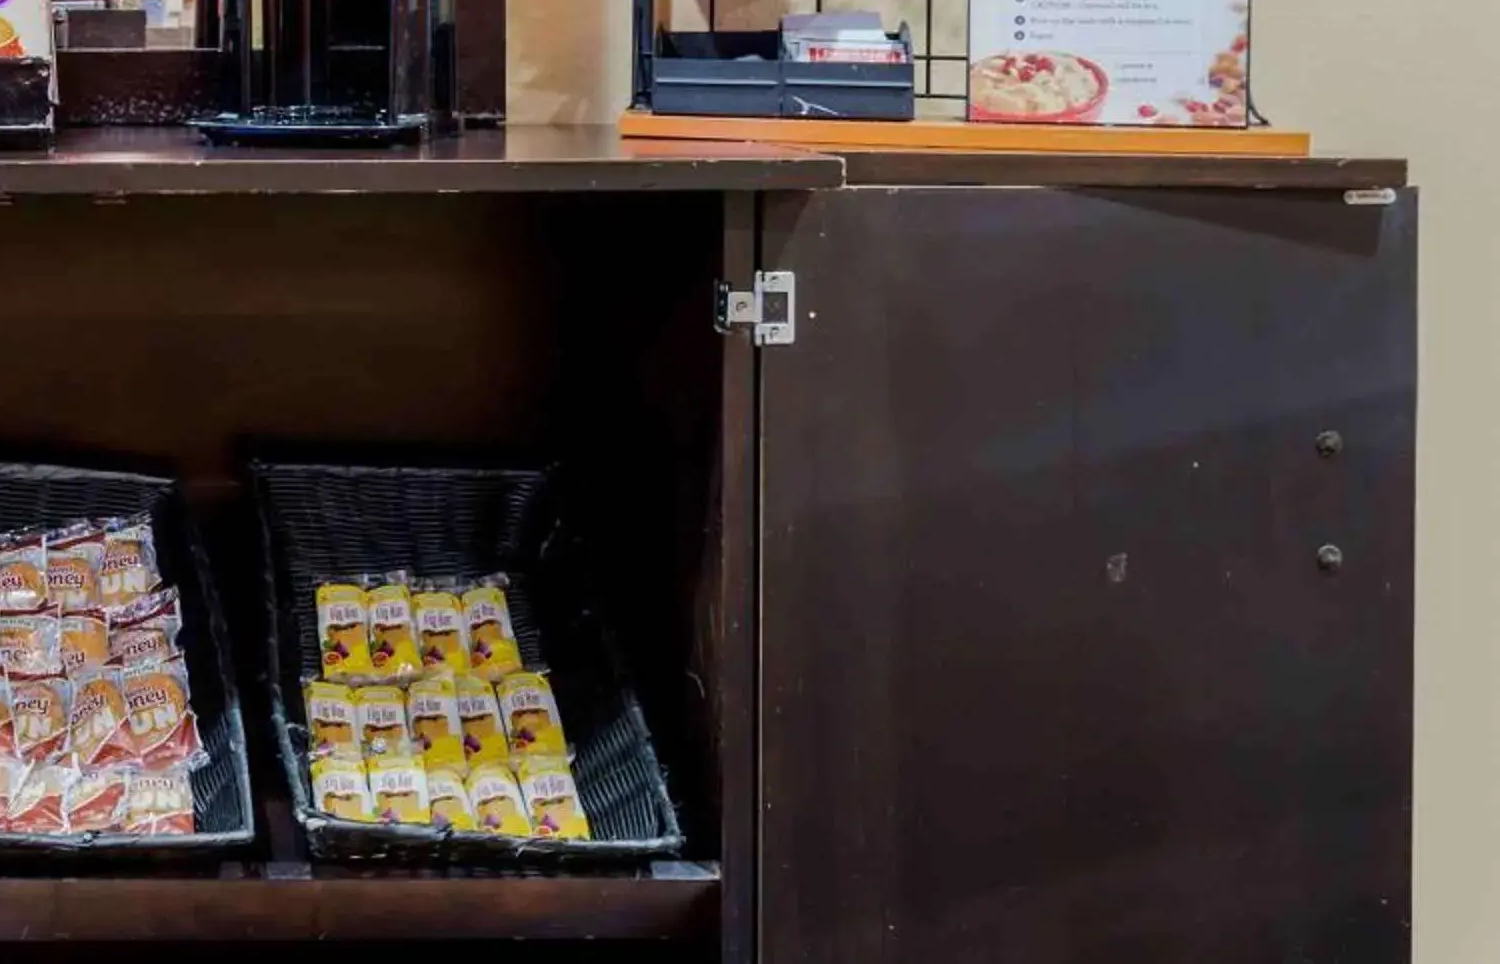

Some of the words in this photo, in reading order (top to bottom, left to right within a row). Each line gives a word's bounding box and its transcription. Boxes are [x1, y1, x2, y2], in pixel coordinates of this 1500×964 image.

[101, 554, 138, 572] oney
[47, 571, 85, 589] oney
[127, 637, 158, 655] ney
[14, 698, 50, 715] ney
[70, 695, 105, 725] oney
